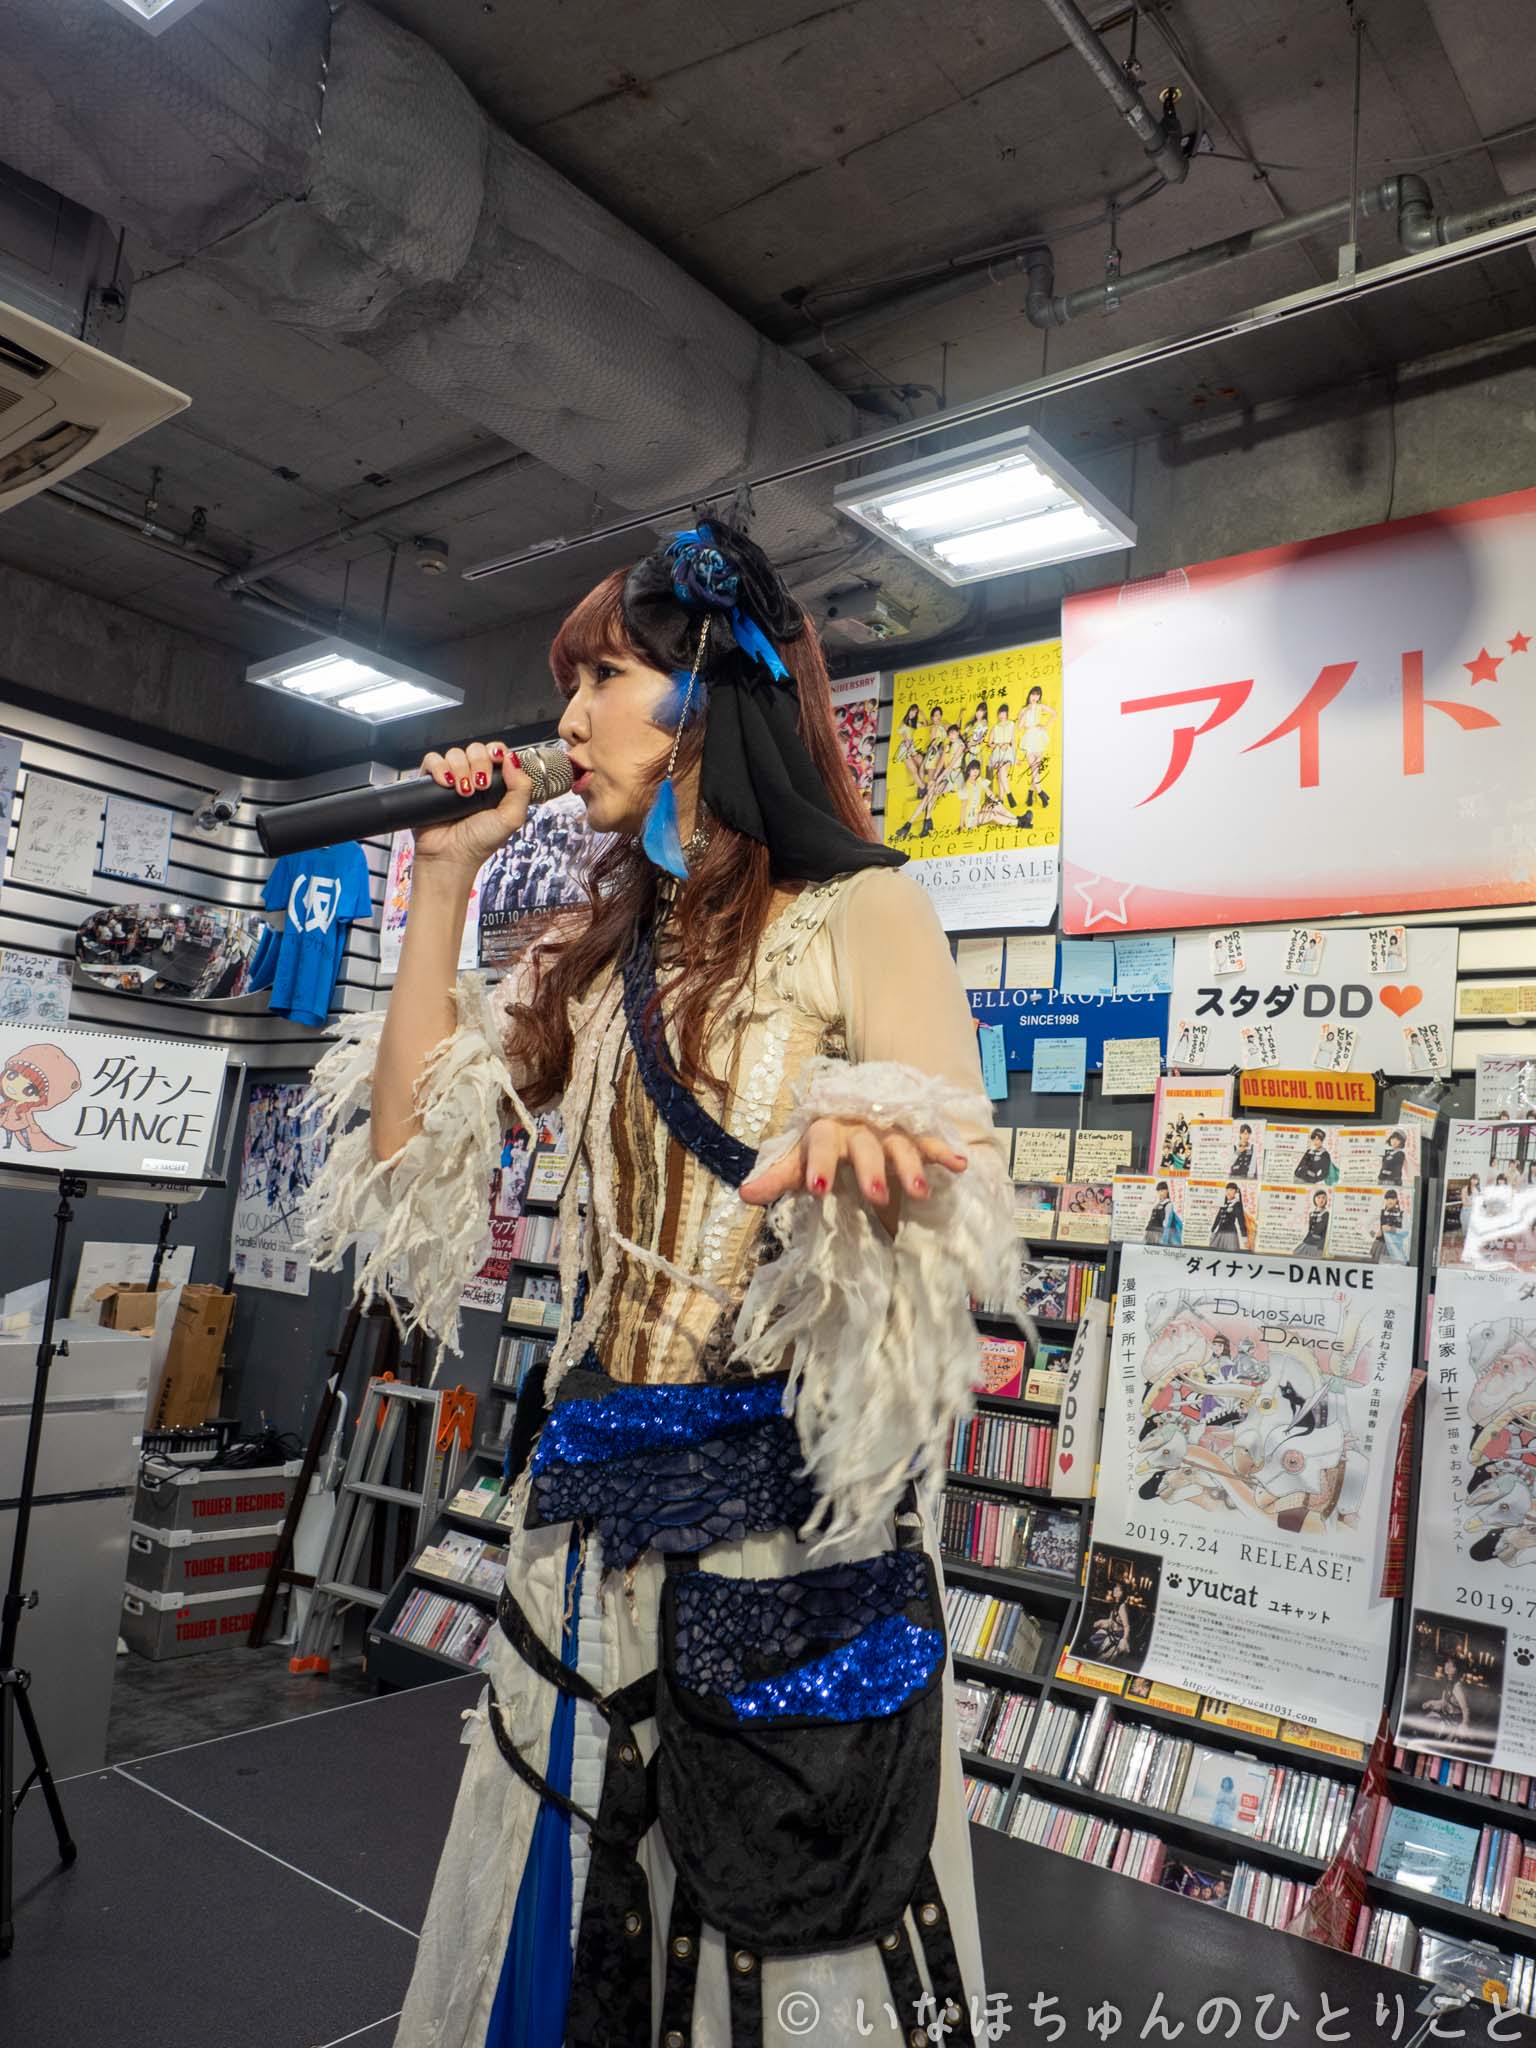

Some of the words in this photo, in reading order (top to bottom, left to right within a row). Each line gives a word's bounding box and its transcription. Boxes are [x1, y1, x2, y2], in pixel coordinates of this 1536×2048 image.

[1121, 630, 1533, 808] アイド
[1001, 860, 1054, 880] SALE
[1019, 1014, 1080, 1026] SINCE1998
[1195, 983, 1373, 1018] スタダDD
[89, 1055, 212, 1105] ダイナソー
[1243, 1078, 1260, 1095] NO
[1315, 1081, 1334, 1098] NO
[1337, 1082, 1371, 1102] LIFE.
[74, 1106, 205, 1148] DANCE
[1143, 1246, 1162, 1256] New
[1163, 1247, 1187, 1259] Single
[1186, 1256, 1374, 1289] ダイナソーDANCE
[1122, 1278, 1136, 1323] 漫画家
[1438, 1306, 1456, 1358] 漫画家
[1121, 1332, 1136, 1379] 所十三
[1440, 1367, 1461, 1421] 所十三
[192, 1497, 231, 1518] TOWER
[235, 1492, 285, 1512] RECORDS
[184, 1556, 224, 1579] TOWER
[228, 1551, 274, 1573] RECORD
[1125, 1522, 1219, 1555] 2019.7.24
[1240, 1544, 1353, 1583] RELEASE!
[1187, 1576, 1259, 1608] yucat
[1267, 1600, 1331, 1624] ユキャット
[176, 1620, 216, 1641] TOWER
[1182, 1677, 1318, 1725] http://www.yucat1031.com
